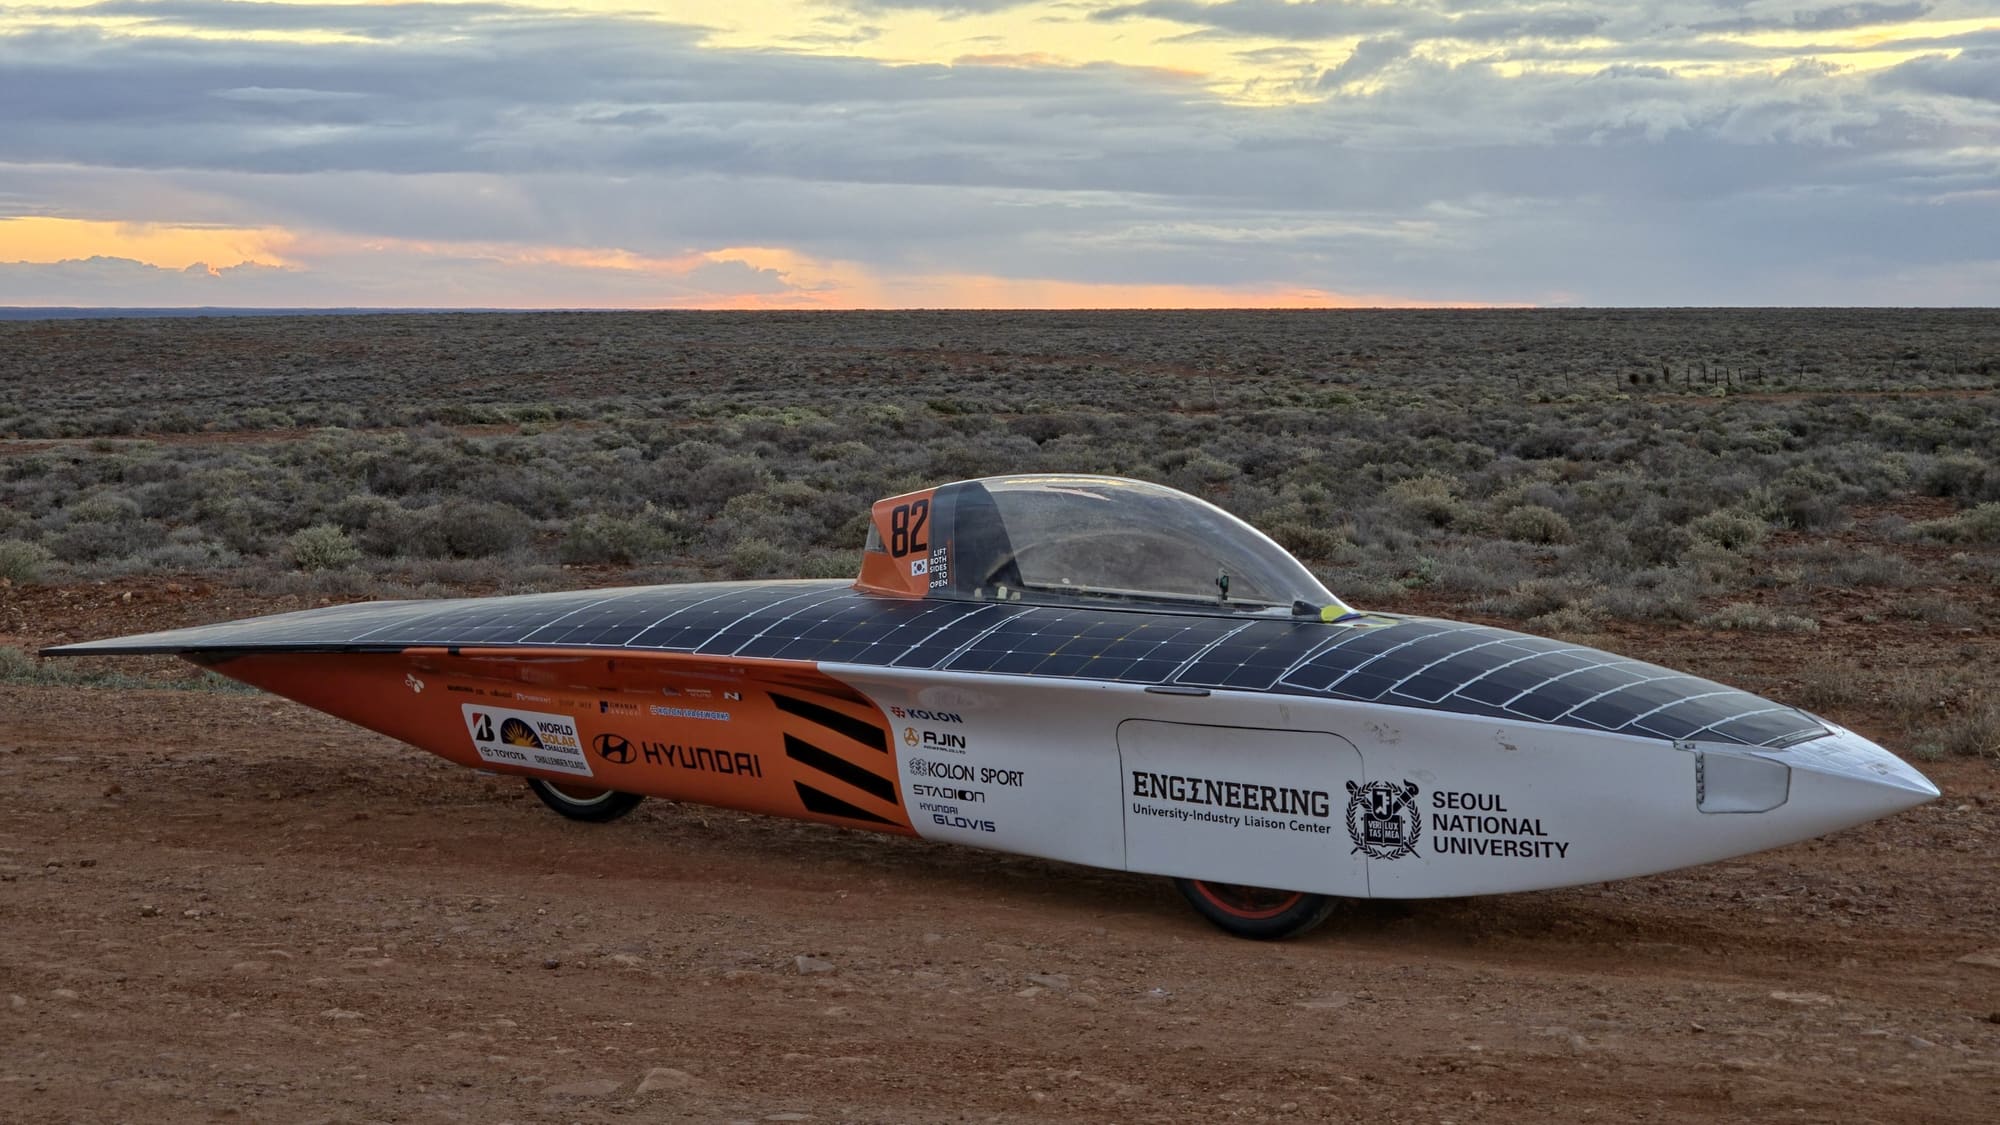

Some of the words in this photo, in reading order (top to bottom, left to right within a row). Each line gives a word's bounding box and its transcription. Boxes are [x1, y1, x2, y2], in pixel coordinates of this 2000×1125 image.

[892, 499, 928, 558] 82
[934, 548, 946, 556] LIFT
[930, 556, 946, 565] BOTH
[930, 564, 947, 573] SIDES
[930, 580, 948, 588] OPEN
[907, 708, 963, 723] KOLON
[537, 722, 572, 736] WORLD
[541, 734, 576, 747] SOLAR
[924, 731, 966, 748] AJIN
[494, 750, 526, 761] TOYOTA
[544, 744, 580, 755] CHALLENGE
[535, 756, 566, 767] CHALLENGER
[568, 760, 586, 770] CLASS
[642, 742, 762, 778] HYUNDAI
[928, 762, 974, 782] KOLON
[981, 768, 1024, 787] SPORT
[914, 784, 984, 802] STADION
[1132, 771, 1329, 818] ENGINEERING
[920, 802, 958, 815] HYUNDAI
[1432, 791, 1507, 812] SEOUL
[933, 814, 995, 832] GLOVIS
[1133, 804, 1240, 827] University-Industry
[1244, 816, 1286, 830] Liaison
[1290, 820, 1332, 834] Center
[1368, 820, 1382, 829] VERI
[1384, 821, 1399, 830] LUX
[1432, 814, 1548, 836] NATIONAL
[1369, 828, 1382, 838] TAS
[1384, 830, 1400, 839] MEA
[1433, 836, 1570, 858] UNIVERSITY
